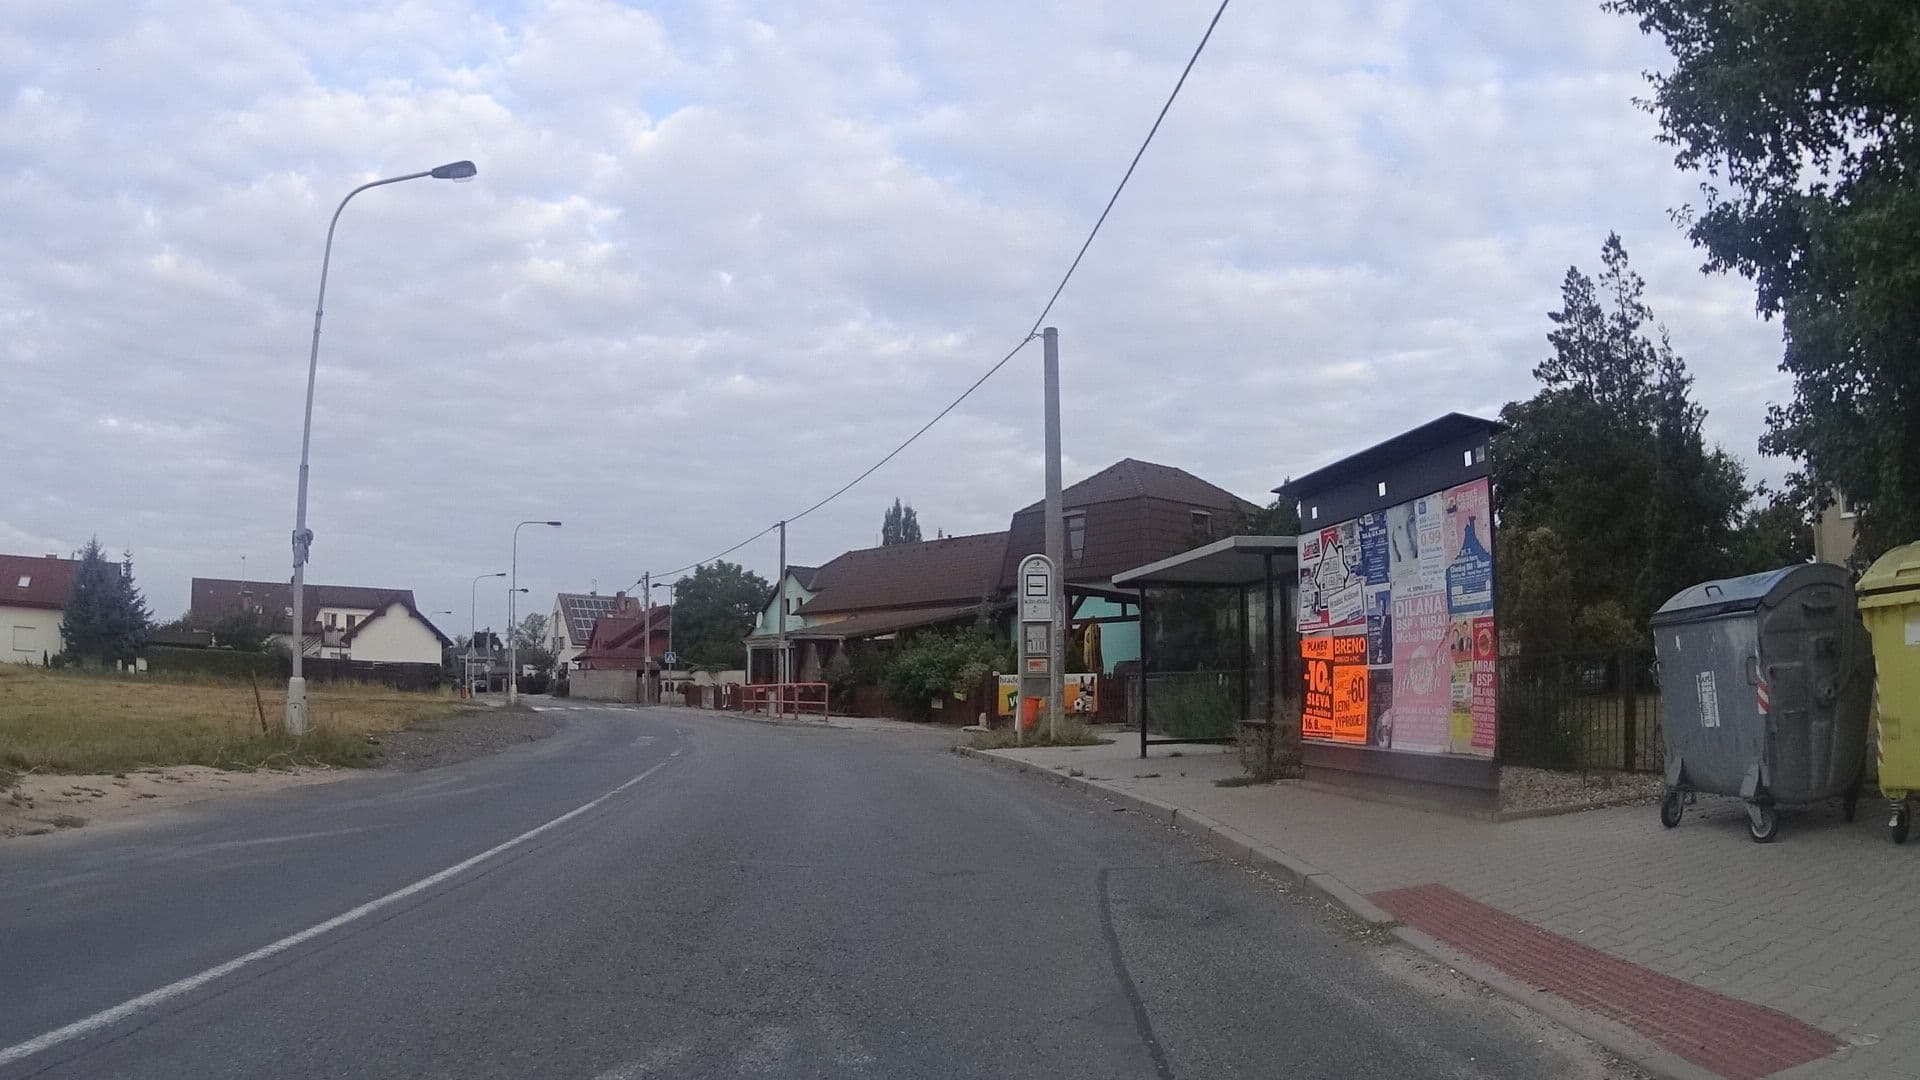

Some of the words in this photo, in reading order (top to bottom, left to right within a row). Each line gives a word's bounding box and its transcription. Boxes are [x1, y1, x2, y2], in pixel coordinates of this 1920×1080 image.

[1396, 618, 1413, 631] BSP
[1335, 637, 1366, 655] BRENO
[1476, 674, 1492, 686] BSP
[1307, 692, 1331, 708] SLEVA
